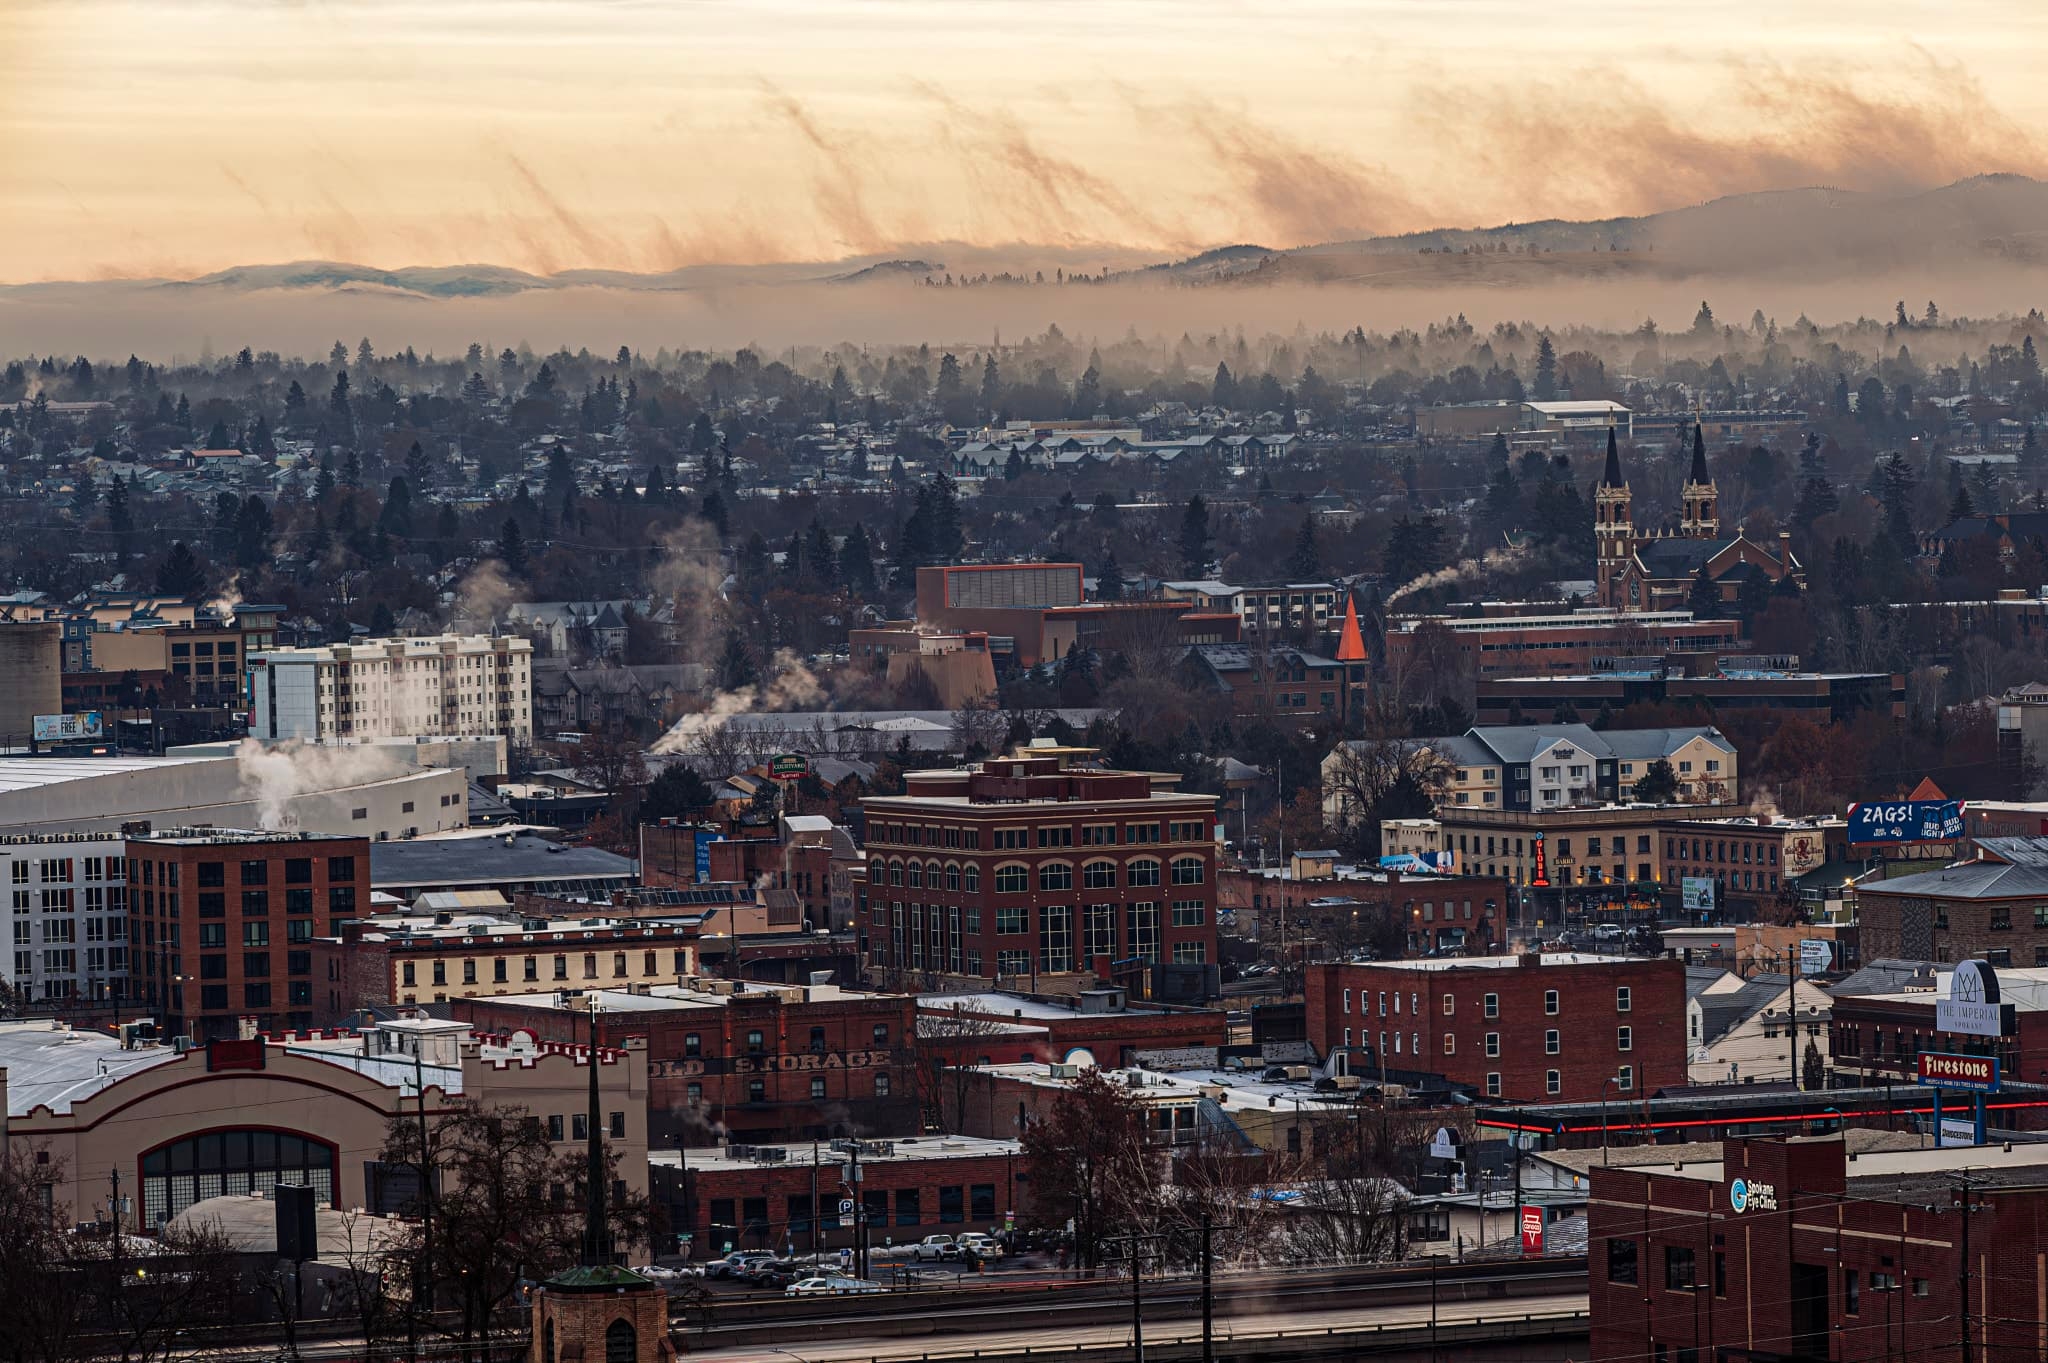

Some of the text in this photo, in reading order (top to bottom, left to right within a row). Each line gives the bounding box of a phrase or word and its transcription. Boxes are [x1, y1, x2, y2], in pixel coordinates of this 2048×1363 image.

[61, 722, 77, 734] FREE
[1863, 804, 1913, 824] ZAGS!
[1924, 822, 1940, 830] BUD
[1943, 817, 1960, 827] BUD
[1921, 828, 1941, 838] LIGHT
[1536, 840, 1544, 878] GLOBE
[1940, 1005, 1999, 1020] THE IMPERIAL
[1955, 1021, 1982, 1030] SPOKANE
[735, 1050, 892, 1073] STORAGE
[1925, 1055, 1988, 1078] Firestone
[1747, 1179, 1774, 1196] Spokane
[843, 1202, 851, 1212] P
[1748, 1195, 1777, 1211] Eye Clinic
